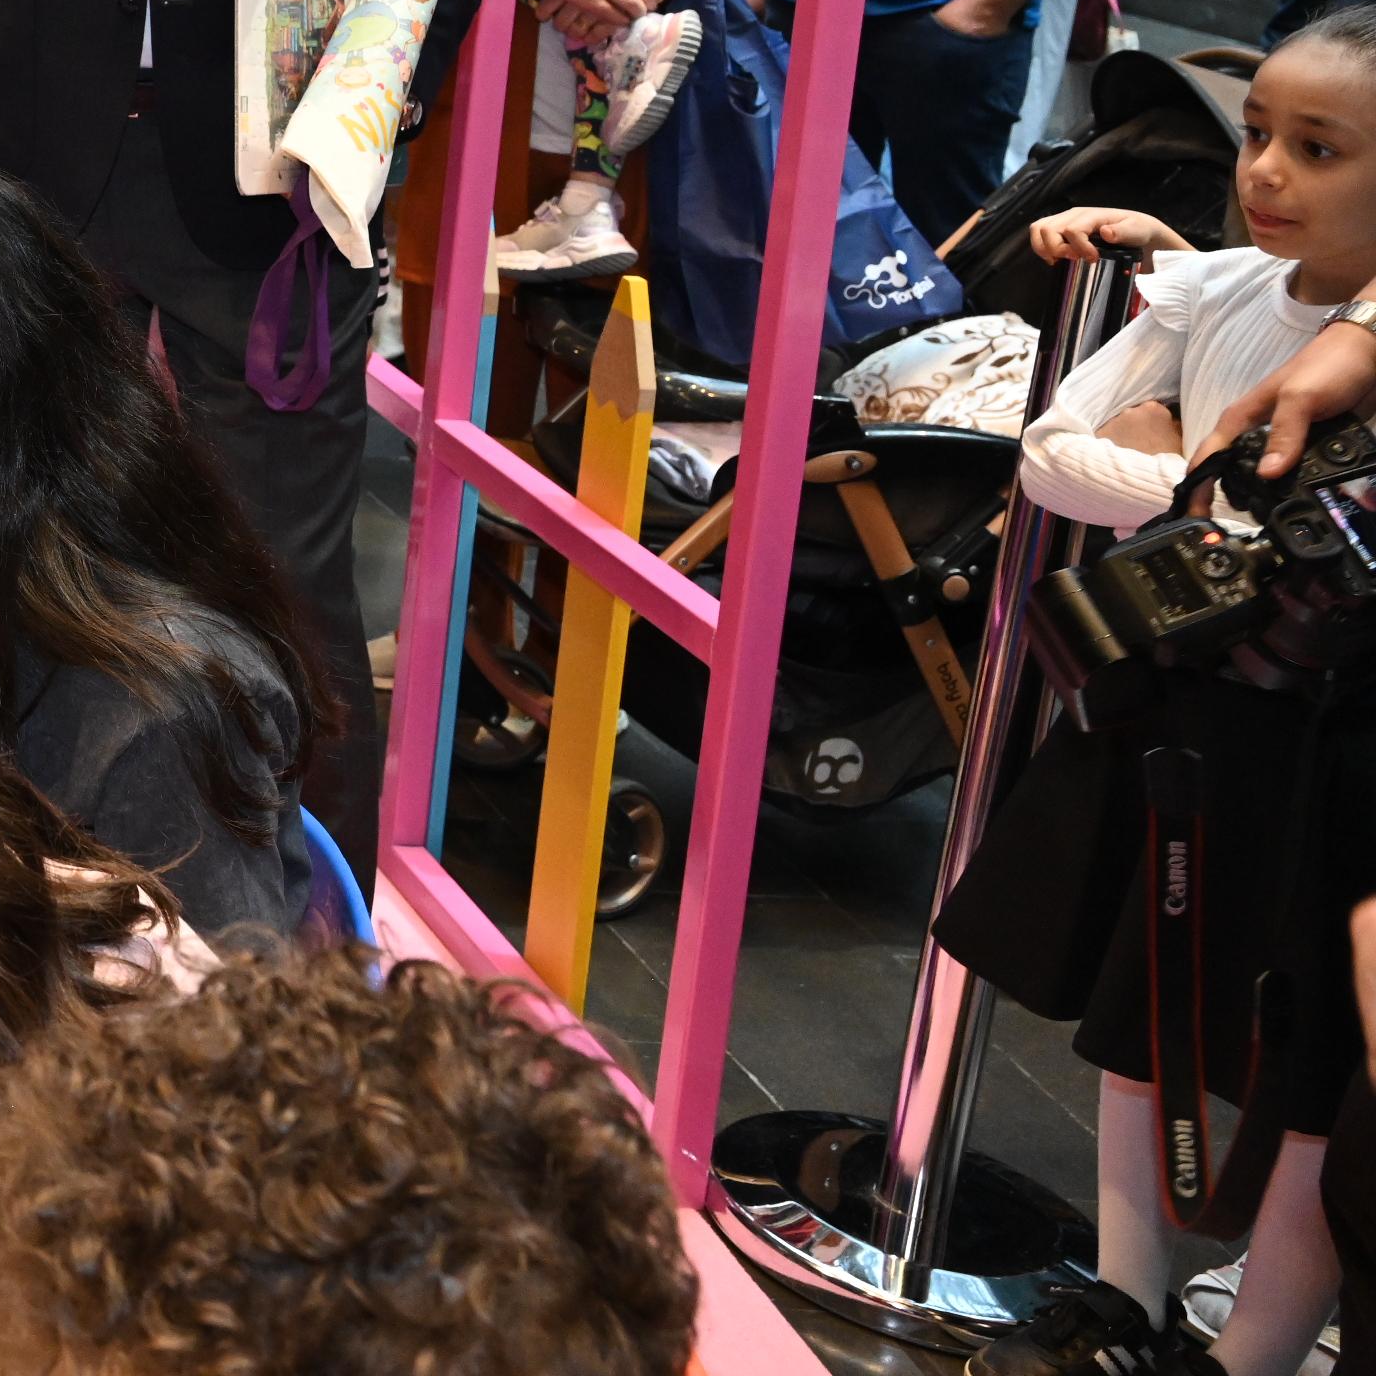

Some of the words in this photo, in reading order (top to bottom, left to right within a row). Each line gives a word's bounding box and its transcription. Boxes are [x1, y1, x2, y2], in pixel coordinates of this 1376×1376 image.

[937, 661, 961, 702] baby
[1165, 841, 1187, 916] Canon
[1173, 1119, 1197, 1199] Canon
